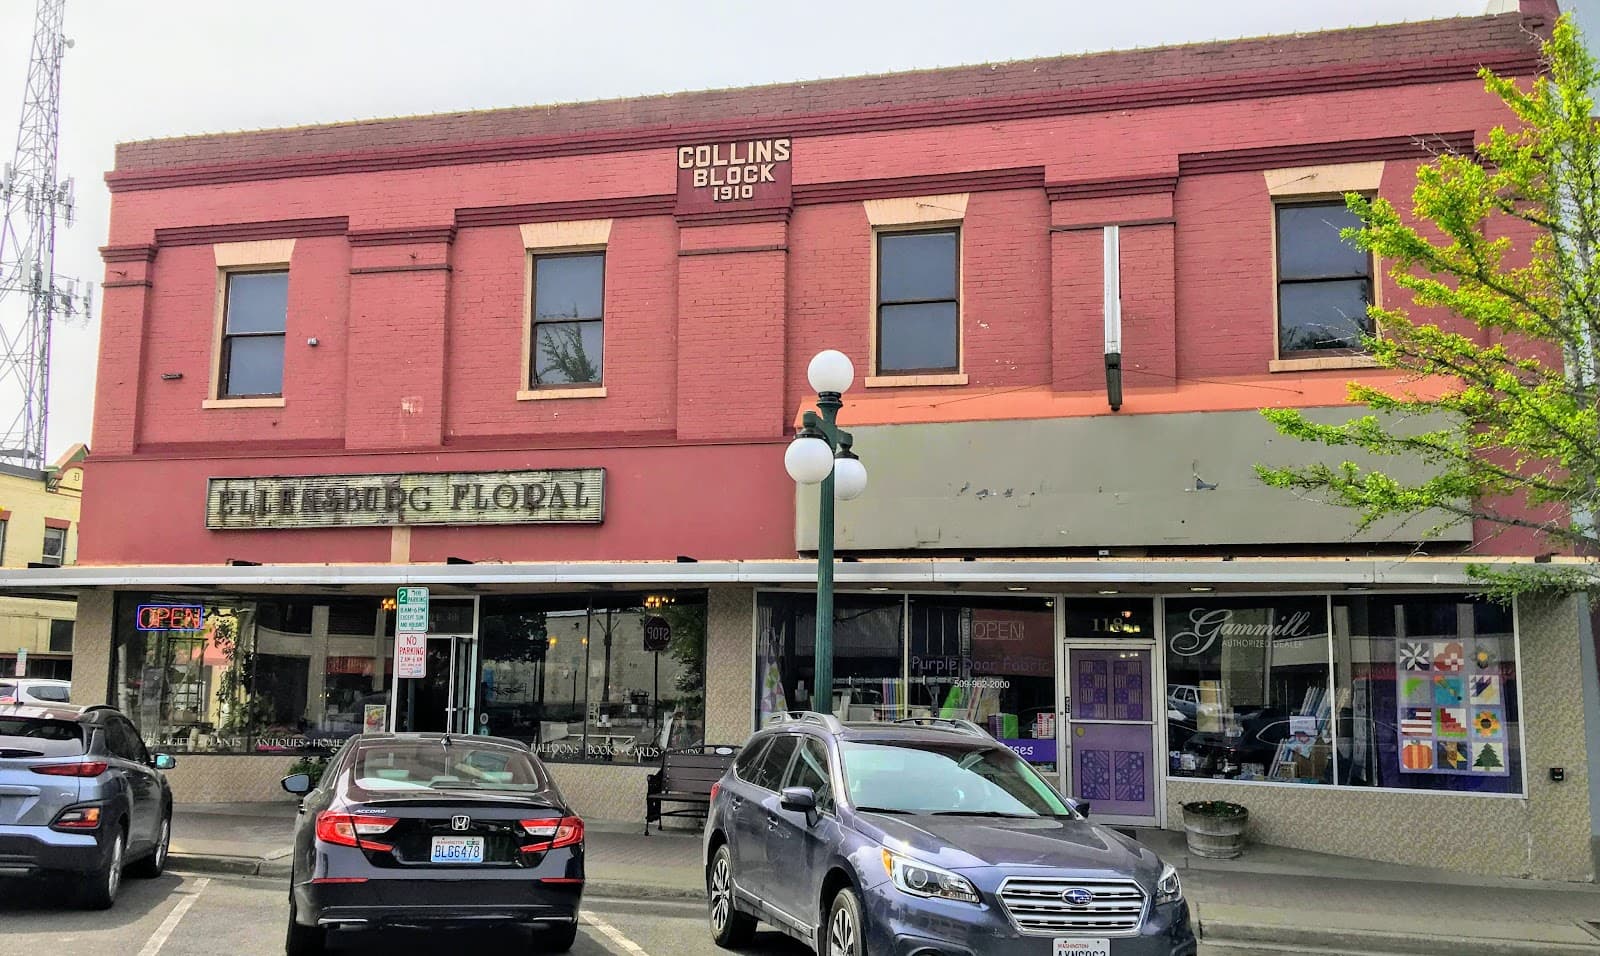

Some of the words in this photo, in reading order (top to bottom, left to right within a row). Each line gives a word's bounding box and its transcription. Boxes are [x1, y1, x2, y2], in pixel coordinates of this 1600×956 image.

[678, 138, 790, 169] COLLINS
[693, 163, 776, 187] BLOCK
[713, 185, 753, 201] 1910
[217, 485, 432, 516] ELLENSBURG
[450, 481, 590, 512] FLORAL
[399, 590, 407, 603] 2
[139, 607, 201, 628] OPEN
[1091, 617, 1124, 632] 118
[974, 621, 1022, 640] OPEN
[1169, 607, 1311, 657] Gammill
[406, 636, 417, 646] NO
[1222, 639, 1271, 649] AUTHORIZED
[1273, 639, 1305, 649] DEALER
[399, 646, 424, 656] PARKING
[911, 655, 958, 675] Purple
[964, 657, 998, 672] Door
[255, 737, 304, 749] ANTIQUES
[312, 737, 342, 748] HOME
[530, 743, 580, 754] BALLOONS
[588, 744, 619, 756] BOOKS
[626, 746, 659, 758] CARDS
[434, 845, 480, 858] BLG6478
